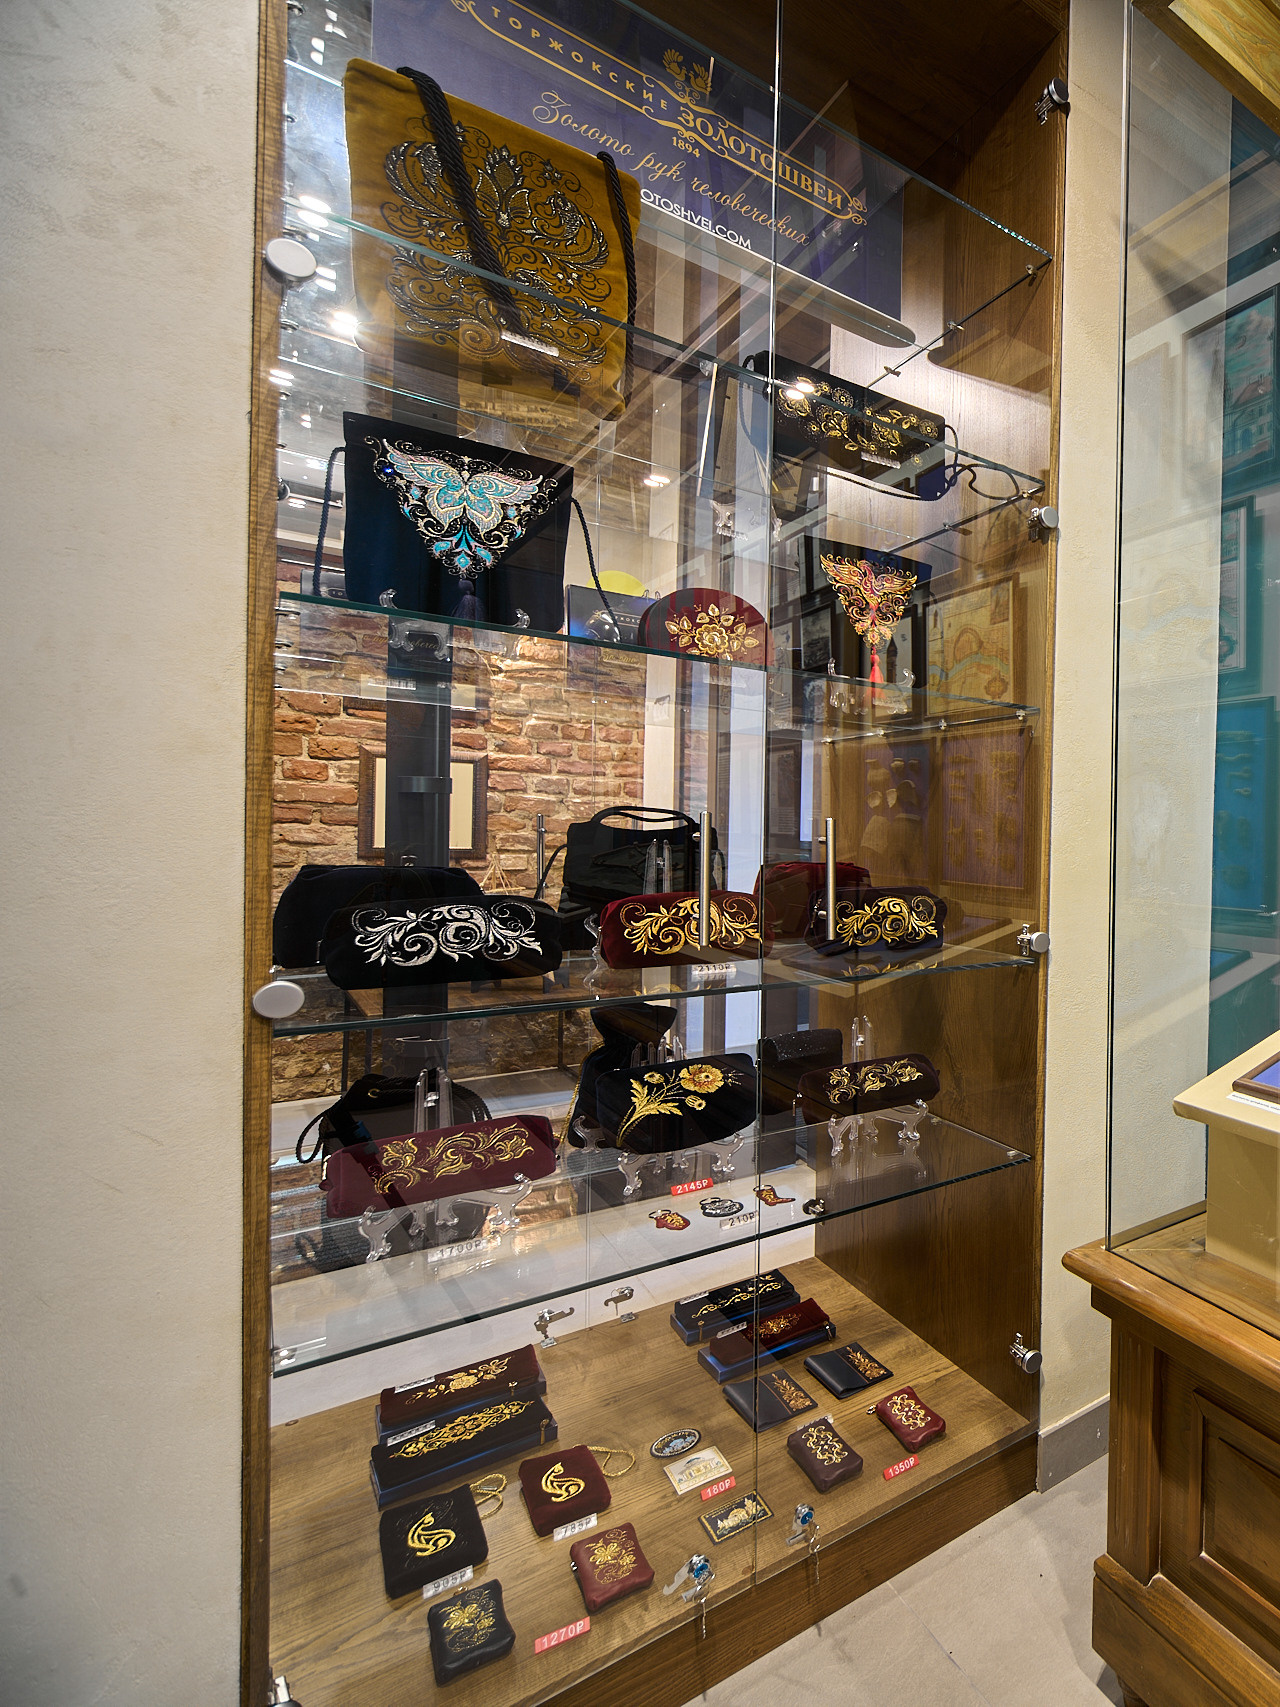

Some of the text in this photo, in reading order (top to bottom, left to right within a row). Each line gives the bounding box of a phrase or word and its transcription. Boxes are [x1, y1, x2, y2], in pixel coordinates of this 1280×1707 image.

[491, 6, 668, 111] ТОРЖОКСКИЕ
[532, 90, 810, 247] Золото рук человеческих
[672, 136, 701, 158] 1894
[677, 106, 843, 210] ЗОЛОТОШВЕИ
